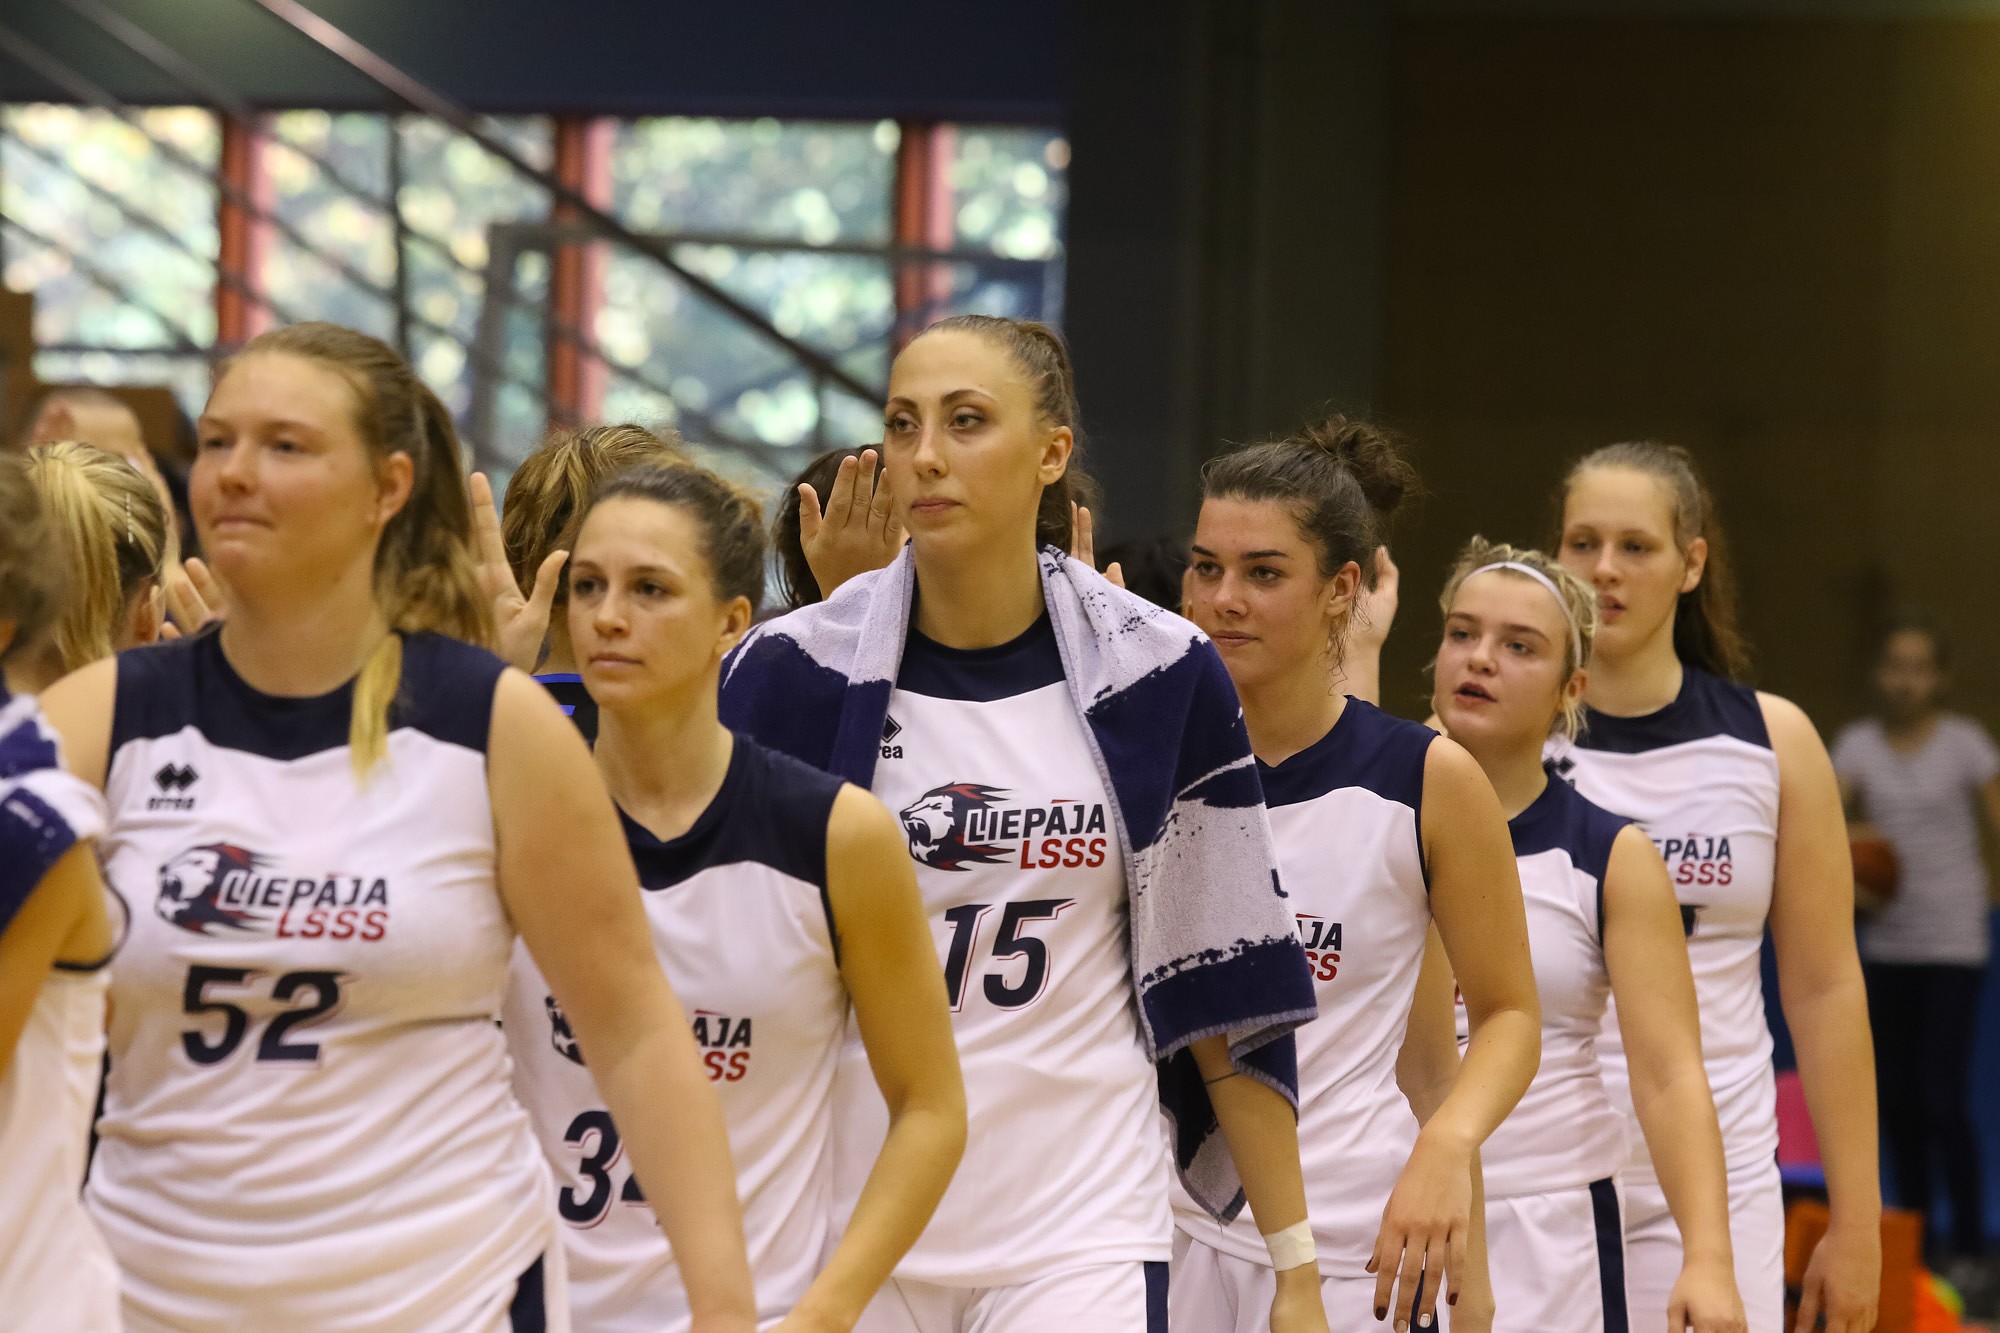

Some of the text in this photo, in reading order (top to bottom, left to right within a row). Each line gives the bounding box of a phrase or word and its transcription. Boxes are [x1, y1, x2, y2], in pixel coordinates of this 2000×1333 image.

[967, 799, 1107, 842] LIEPĀJA
[1020, 838, 1107, 869] LSSS
[1656, 833, 1732, 861] PĀJA
[1676, 863, 1733, 886] SSS
[276, 909, 388, 941] LSSS
[944, 898, 1075, 1012] 15
[181, 965, 348, 1066] 52
[703, 1051, 750, 1082] SS
